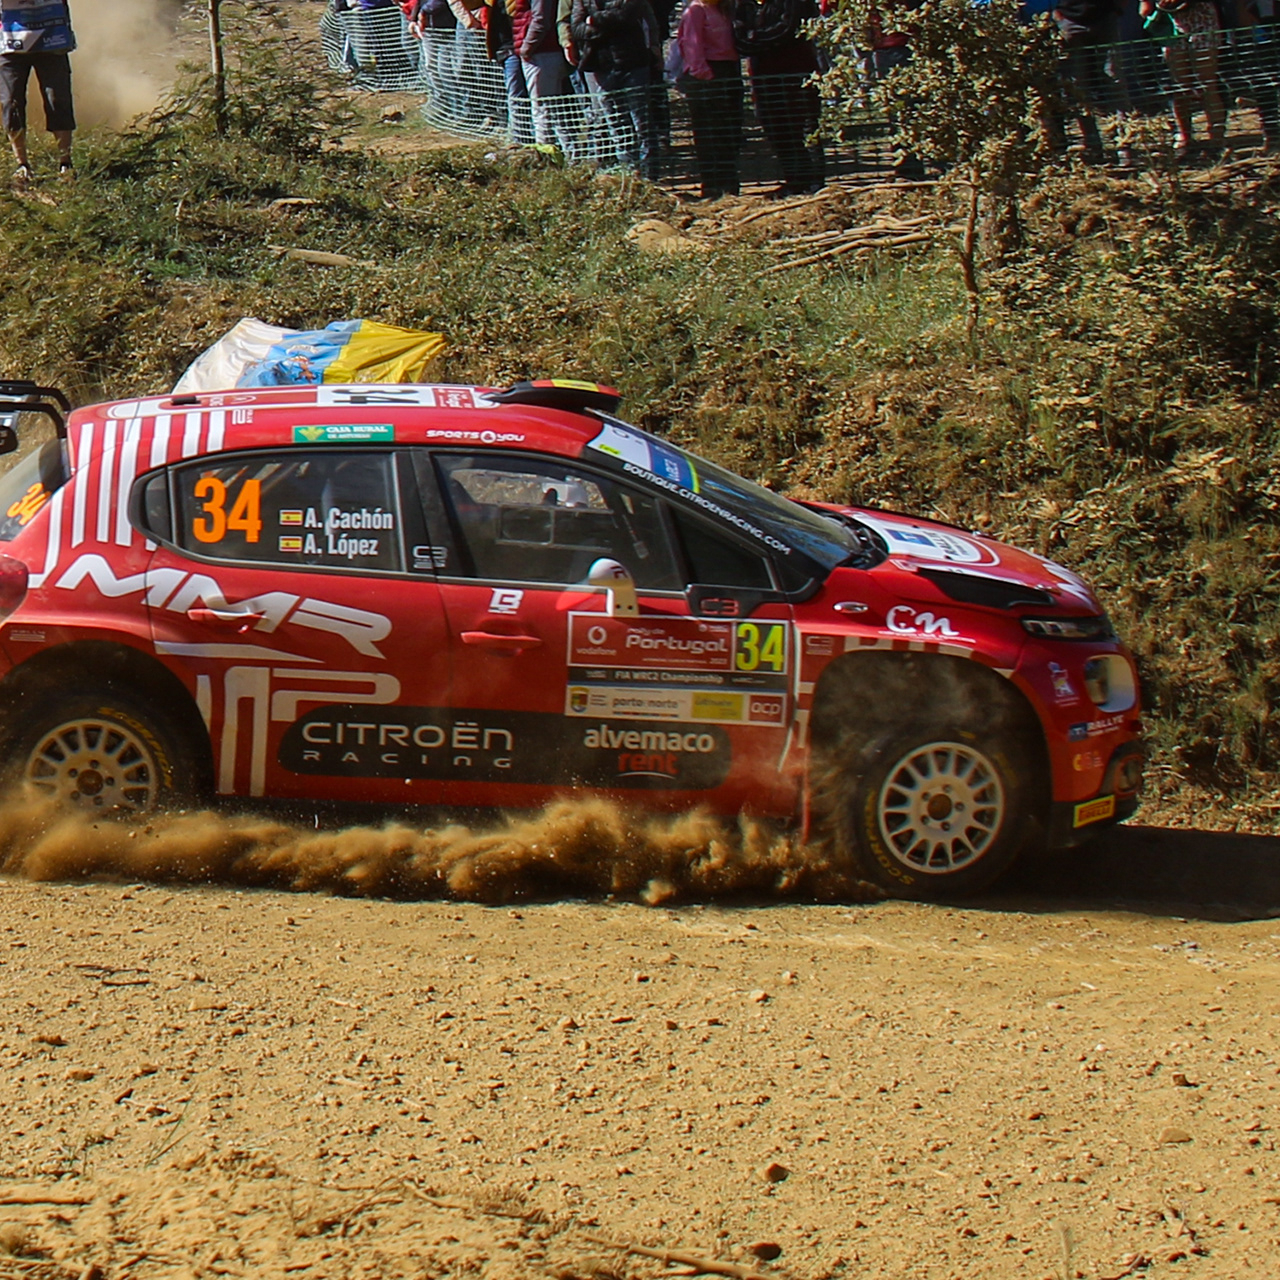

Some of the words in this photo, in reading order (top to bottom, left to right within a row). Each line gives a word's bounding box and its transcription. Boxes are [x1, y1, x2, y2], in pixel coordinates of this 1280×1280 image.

[353, 425, 389, 433] RURAL
[426, 429, 480, 439] SPORTS
[7, 483, 51, 525] 34
[192, 477, 262, 543] 34
[623, 462, 791, 556] BOUTIQUE.CITROENRACING.COM
[304, 508, 322, 528] A.
[328, 507, 393, 530] Cachón
[304, 533, 322, 554] A.
[328, 532, 379, 559] López
[412, 545, 448, 559] C3
[55, 553, 393, 660] MMR
[700, 598, 739, 616] C3
[627, 627, 652, 637] rally
[576, 646, 617, 656] vodafone
[626, 634, 728, 655] Portugal
[736, 623, 784, 671] 34
[614, 671, 627, 680] FIA
[628, 671, 659, 681] WRC2
[660, 672, 724, 684] Championship
[613, 696, 642, 709] porto
[648, 698, 679, 709] norte
[751, 701, 781, 716] acp
[583, 724, 715, 752] alvemaco
[617, 753, 679, 774] rent
